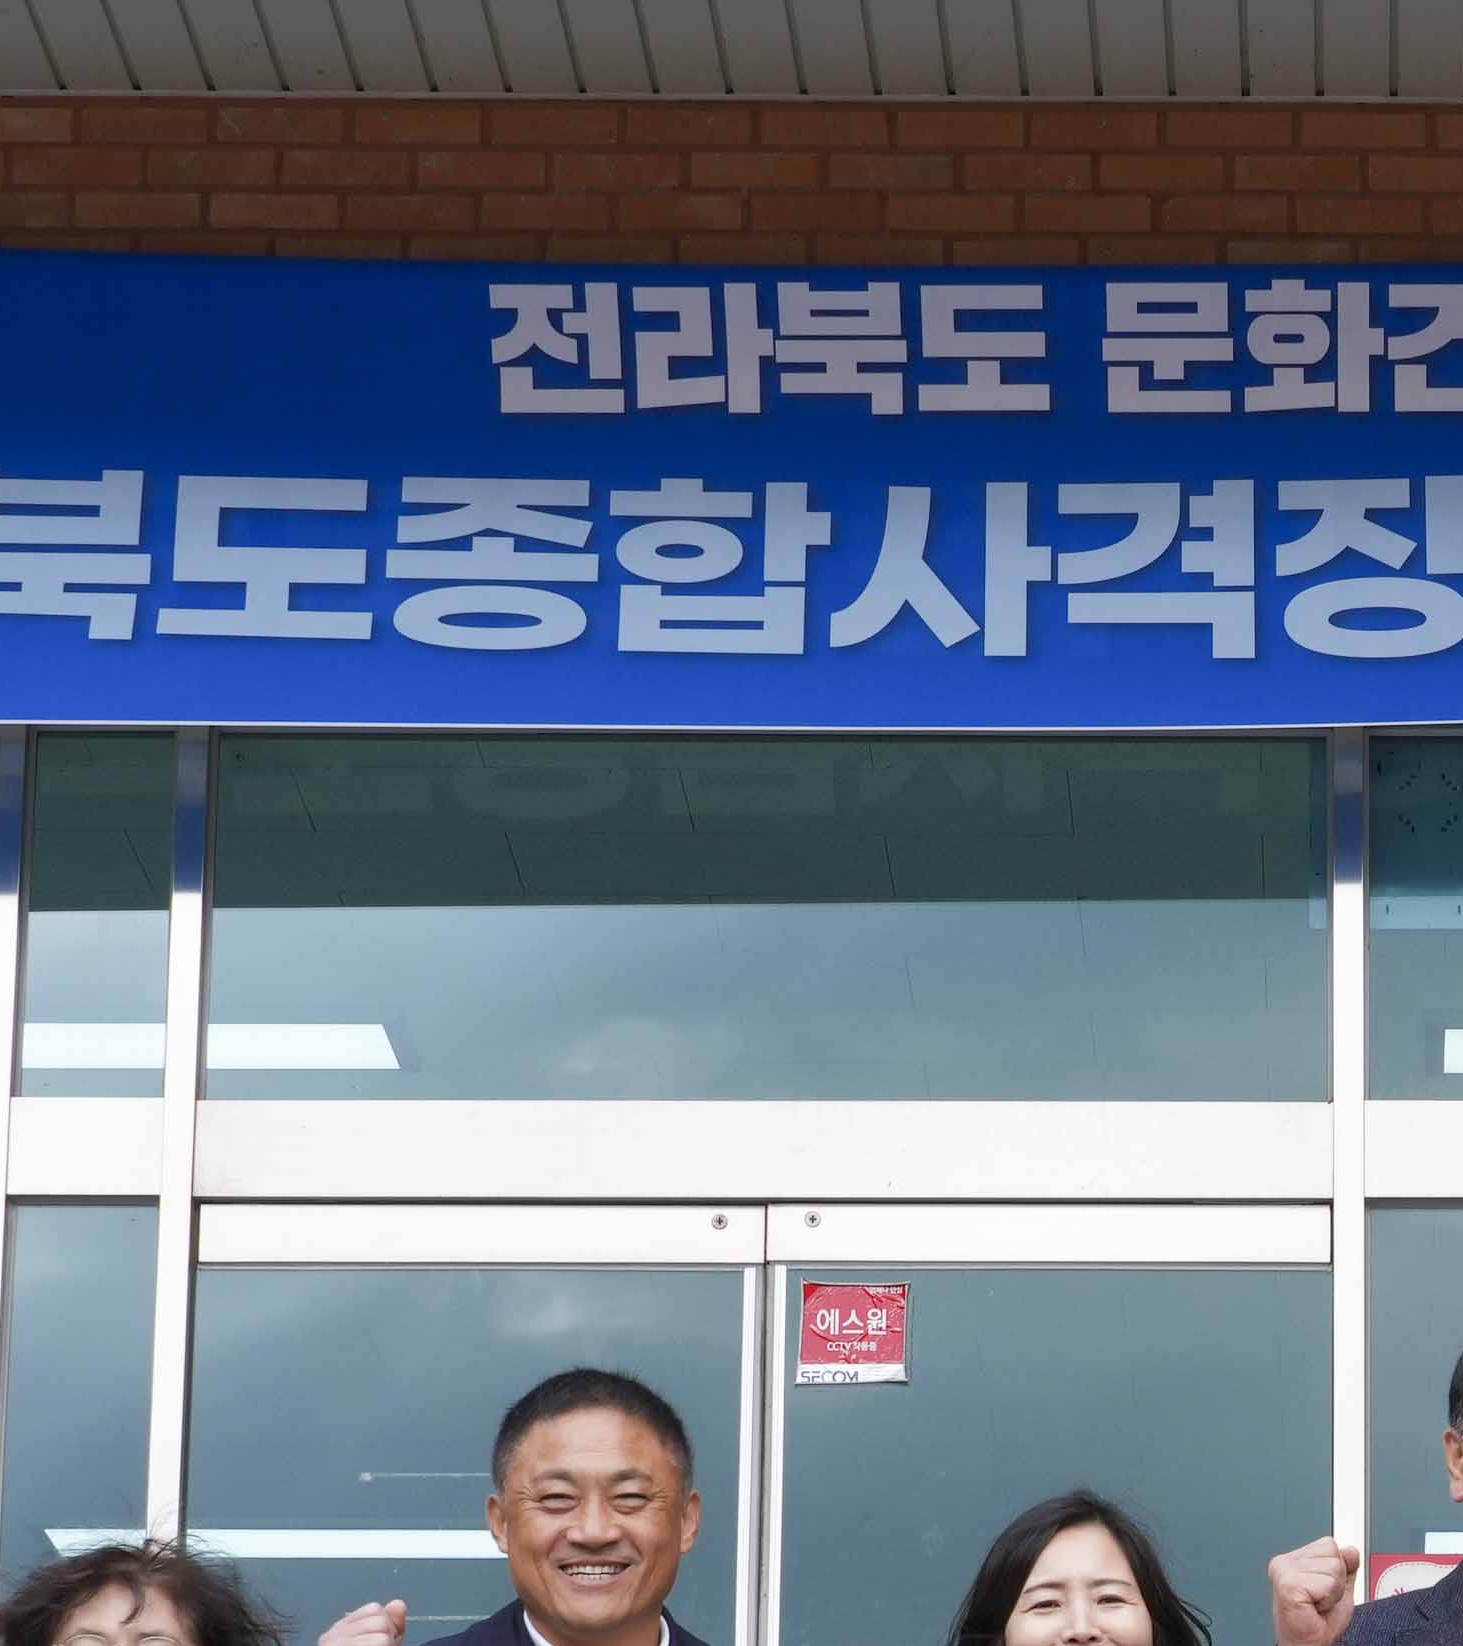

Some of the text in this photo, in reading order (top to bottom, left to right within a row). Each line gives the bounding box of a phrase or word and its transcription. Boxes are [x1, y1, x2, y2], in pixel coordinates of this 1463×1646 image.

[489, 282, 1050, 415] 전라북도
[816, 1308, 888, 1336] 에스원
[827, 1341, 850, 1352] CCTV
